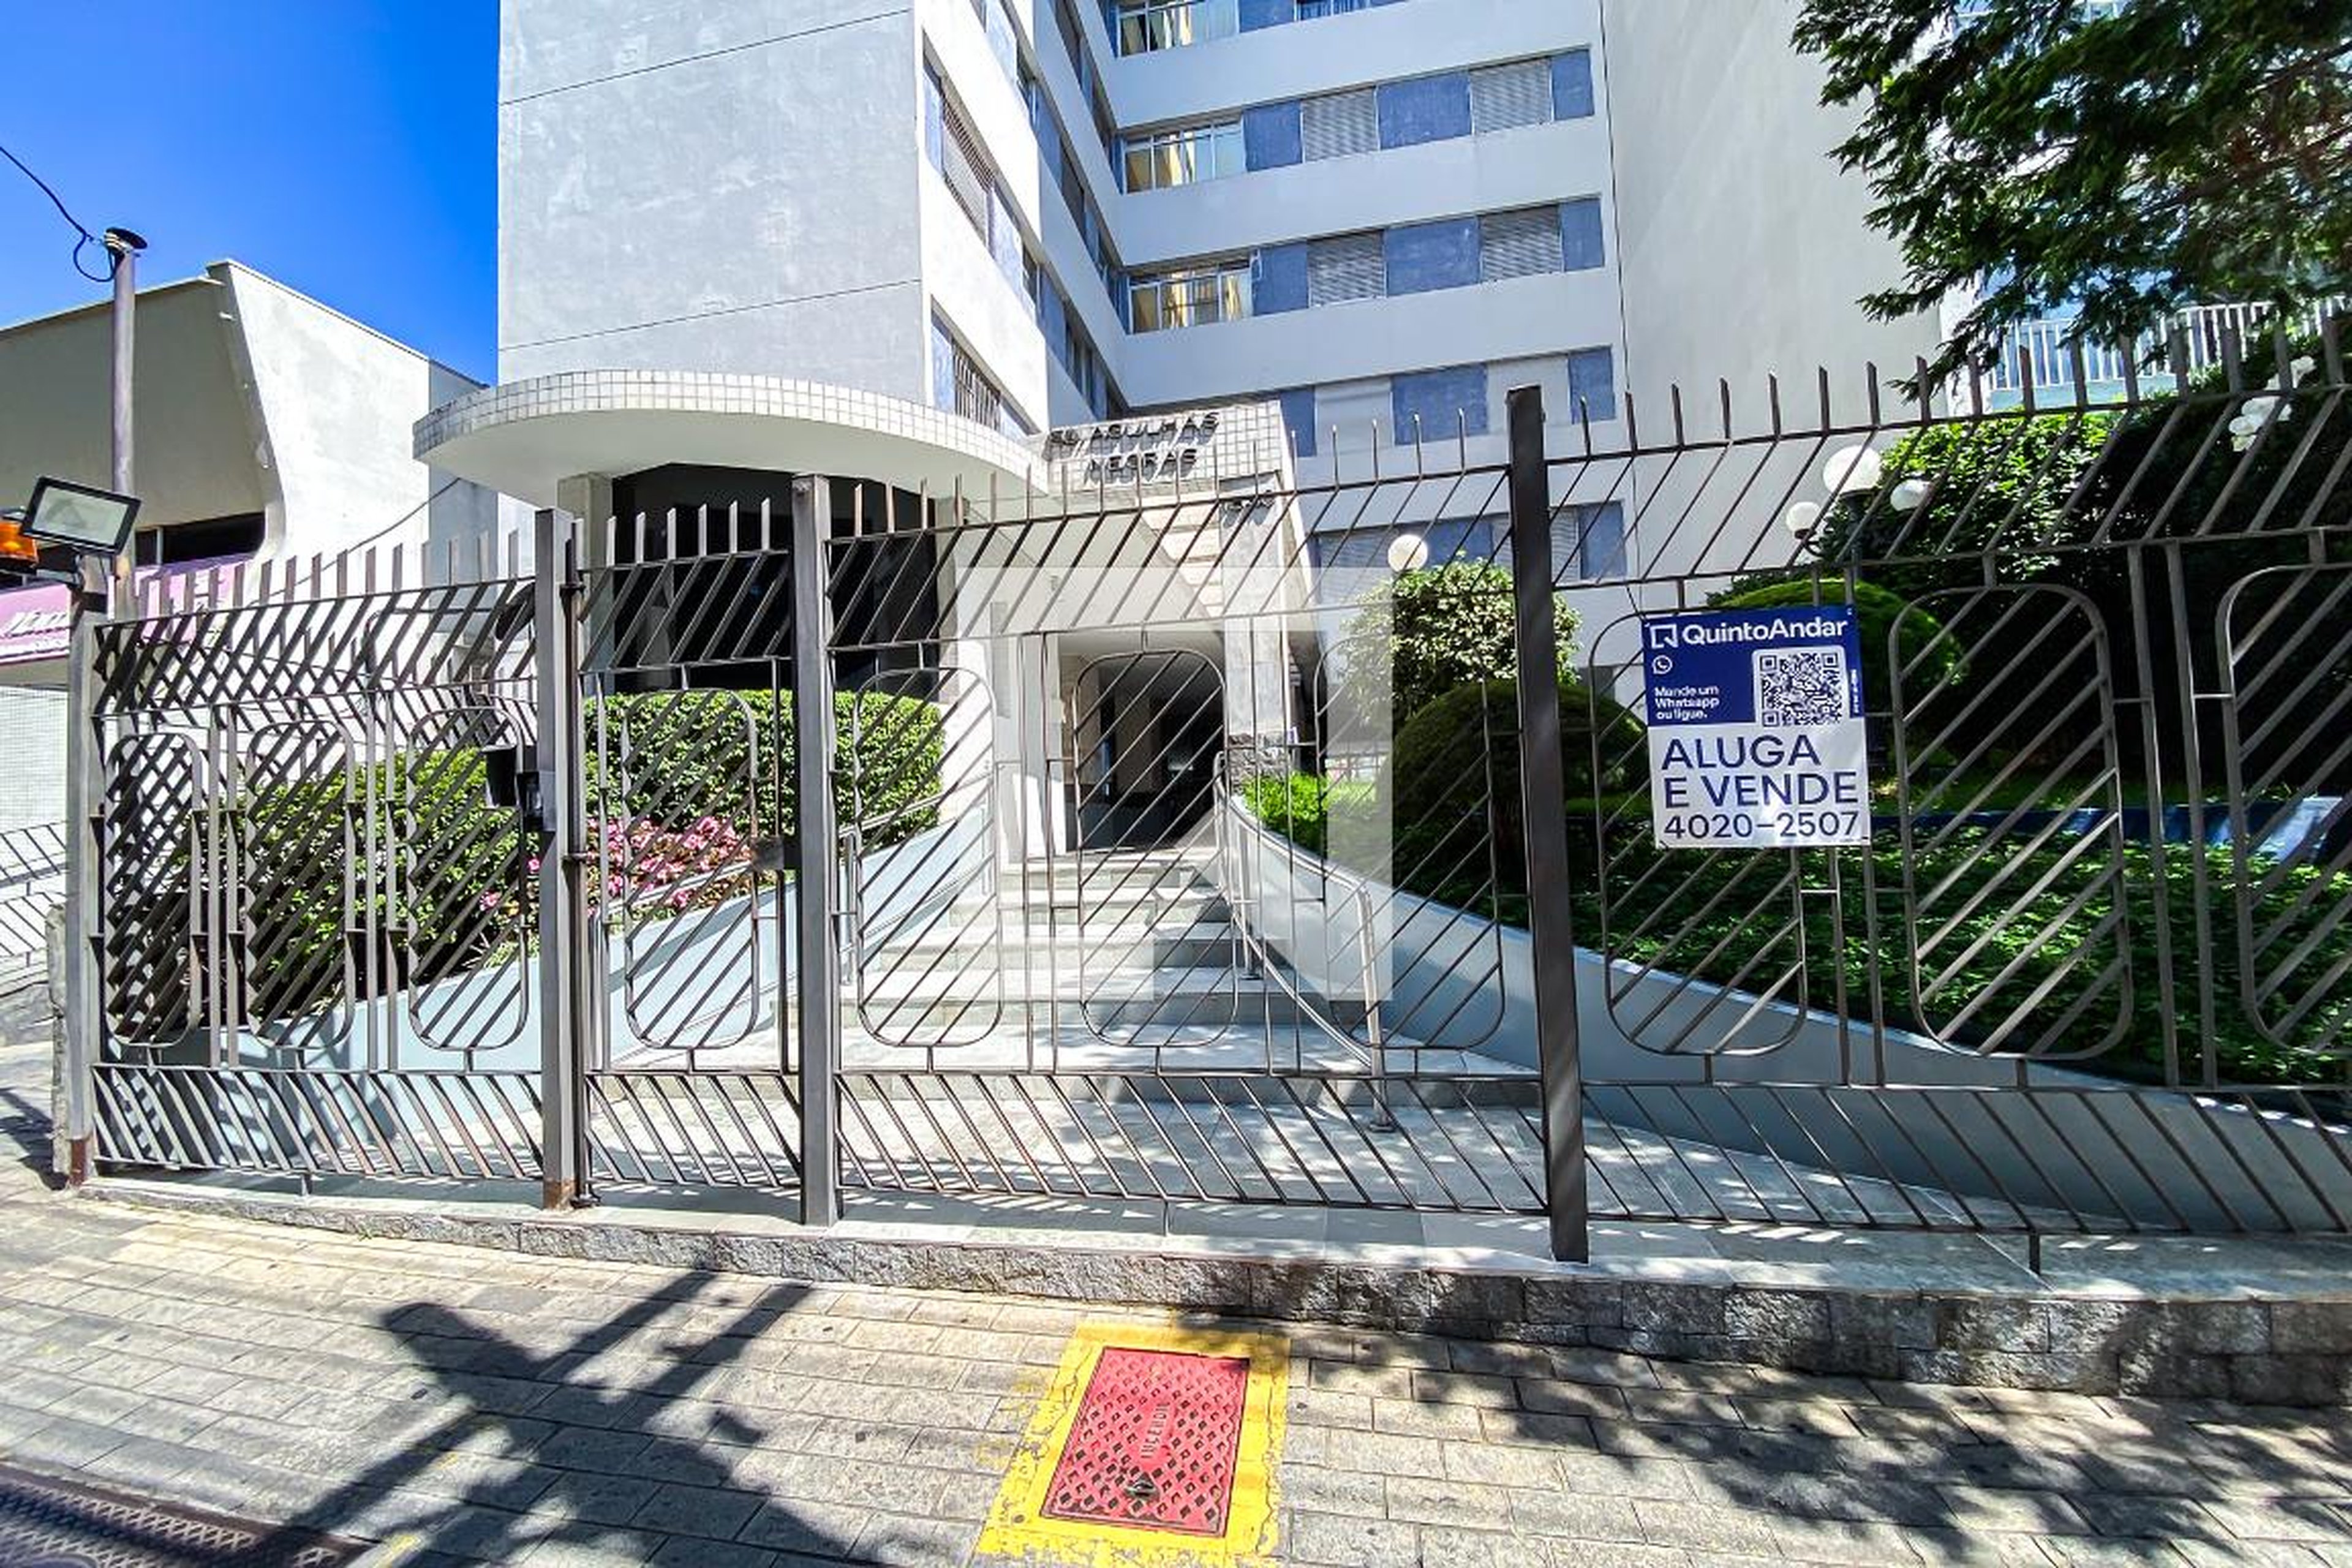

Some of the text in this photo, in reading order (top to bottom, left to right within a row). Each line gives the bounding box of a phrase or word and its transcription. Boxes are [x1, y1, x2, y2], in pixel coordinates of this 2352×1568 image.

[1683, 617, 1848, 644] QuintoAndar
[1655, 685, 1719, 697] Mande um
[1656, 711, 1672, 720] ou
[1662, 735, 1821, 770] ALUGA
[1664, 772, 1858, 808] E VENDE
[1664, 811, 1858, 839] 4020-2507
